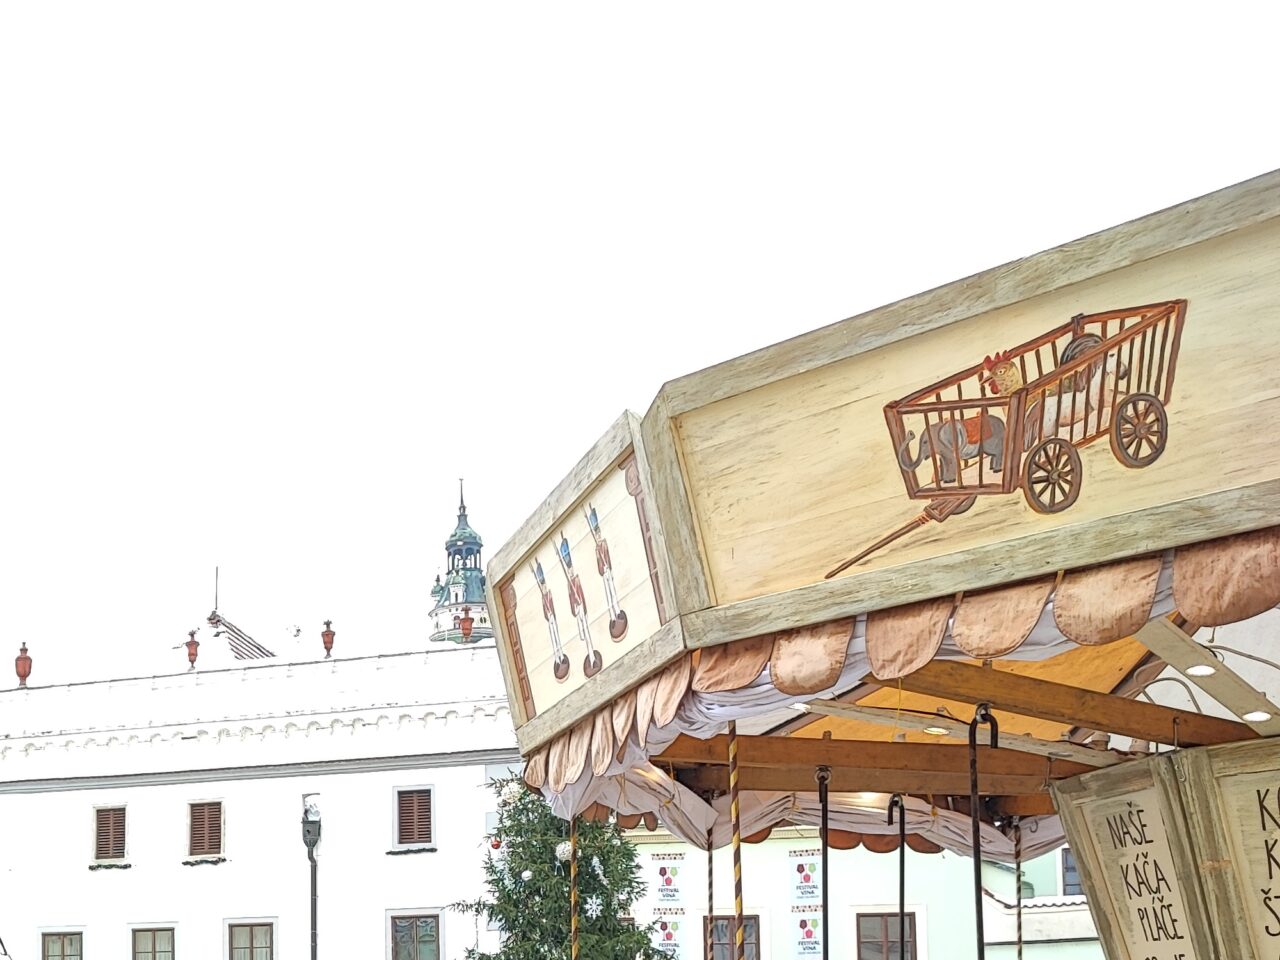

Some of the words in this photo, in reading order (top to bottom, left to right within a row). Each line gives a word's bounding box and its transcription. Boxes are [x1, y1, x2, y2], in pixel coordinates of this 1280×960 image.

[1106, 801, 1154, 850] NAŠE
[1256, 787, 1280, 831] K
[1120, 851, 1172, 900] KÁČA
[1137, 895, 1184, 942] PLÁČE
